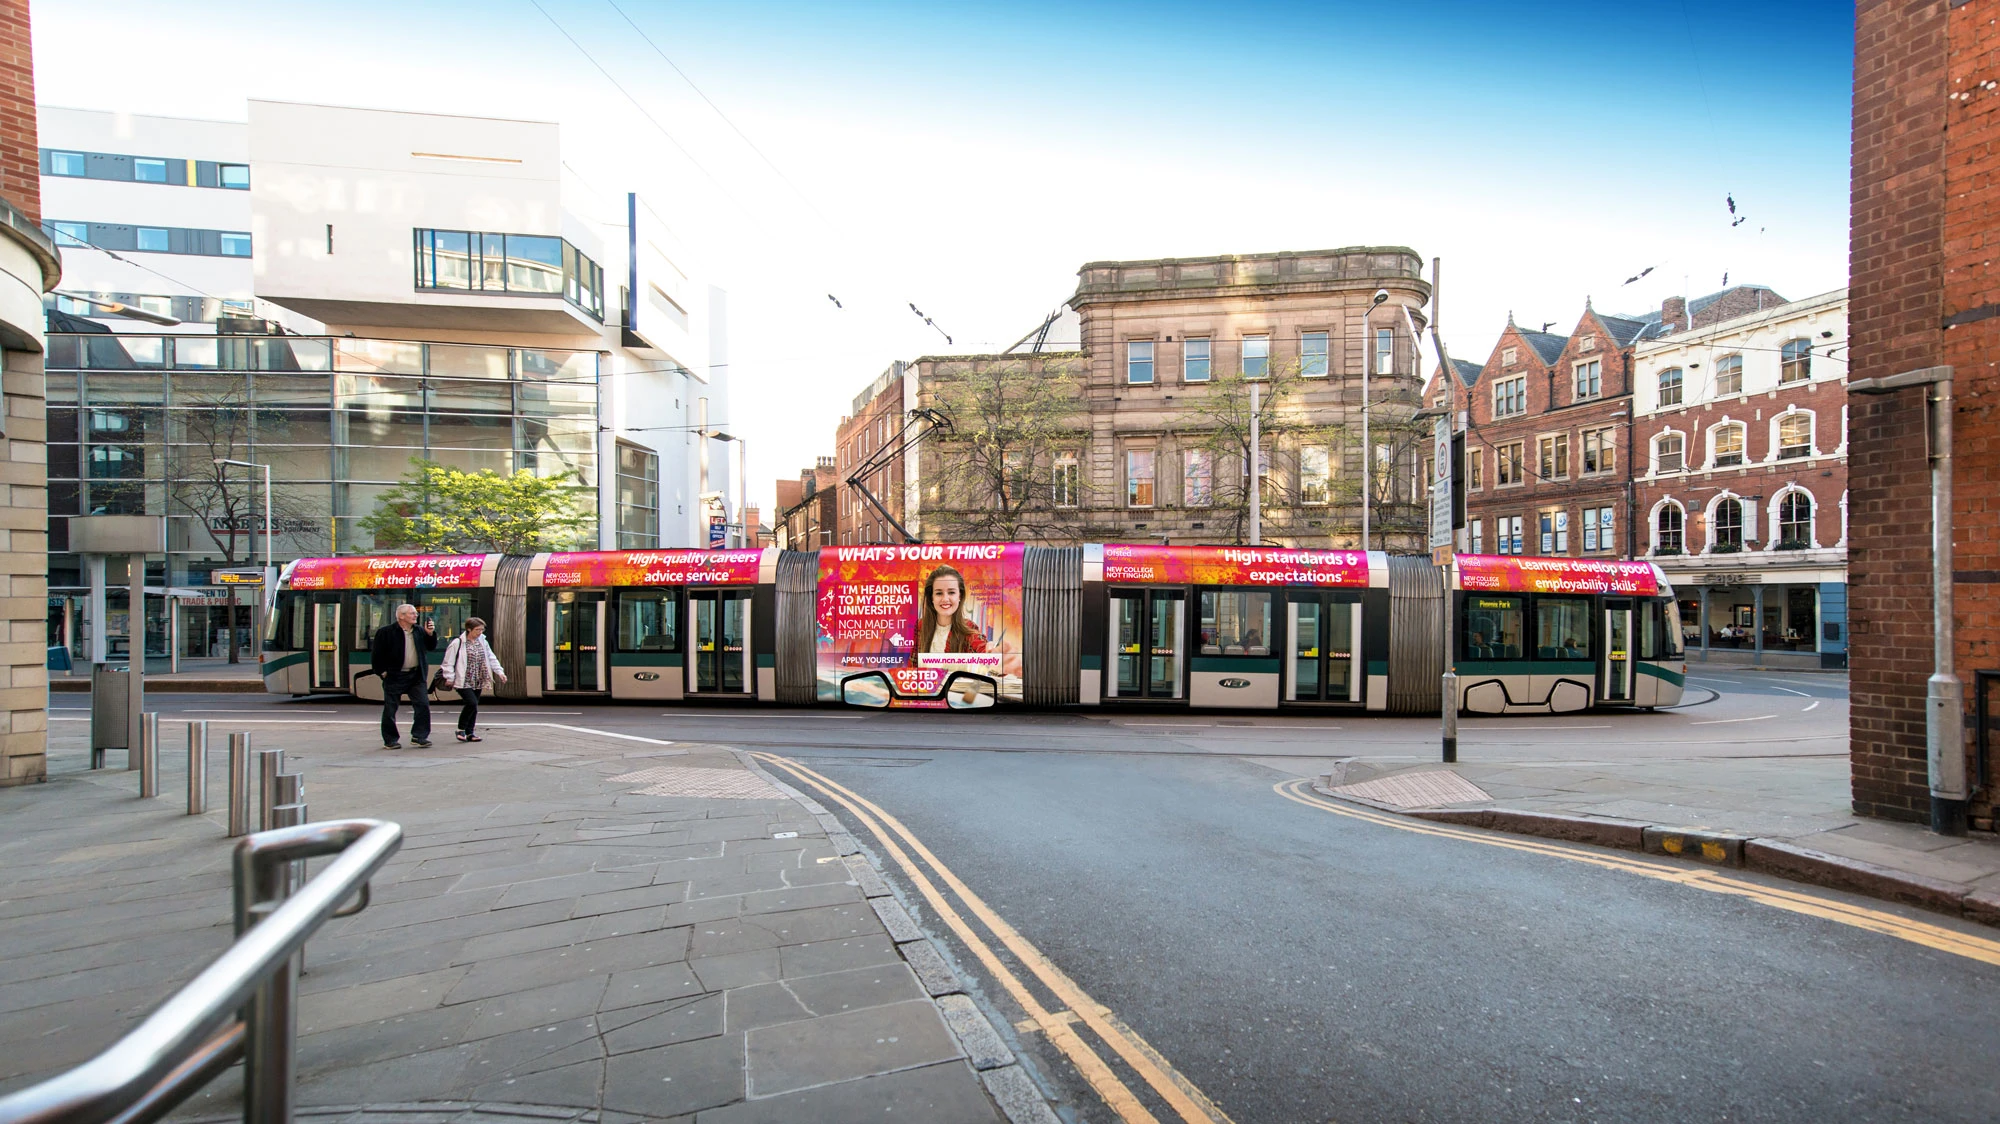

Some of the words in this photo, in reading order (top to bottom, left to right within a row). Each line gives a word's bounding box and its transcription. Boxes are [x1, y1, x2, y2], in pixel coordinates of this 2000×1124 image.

[838, 547, 896, 561] WHAT'S
[900, 547, 943, 561] YOUR
[947, 545, 1005, 560] THING?
[1106, 549, 1132, 557] Ofsted
[417, 560, 436, 568] are
[438, 558, 482, 570] experts
[709, 555, 757, 563] careers
[1265, 553, 1343, 565] standards
[1346, 553, 1358, 565] &
[1572, 561, 1617, 576] develop
[1620, 563, 1650, 576] good
[375, 575, 384, 585] in
[387, 574, 412, 585] their
[644, 569, 684, 582] advice
[861, 584, 910, 594] HEADING
[1536, 579, 1609, 592] employability
[218, 589, 226, 597] TO
[838, 595, 854, 604] TO
[856, 595, 872, 604] MY
[875, 595, 912, 604] DREAM
[838, 605, 902, 615] UNIVERSITY.
[838, 619, 862, 629] NCN
[865, 619, 894, 629] MADE
[897, 619, 907, 629] IT
[841, 656, 864, 665] APPLY,
[866, 656, 904, 664] YOURSELF.
[922, 657, 1000, 666] www.ncn.ac.uk/apply
[897, 670, 939, 681] OFSTED
